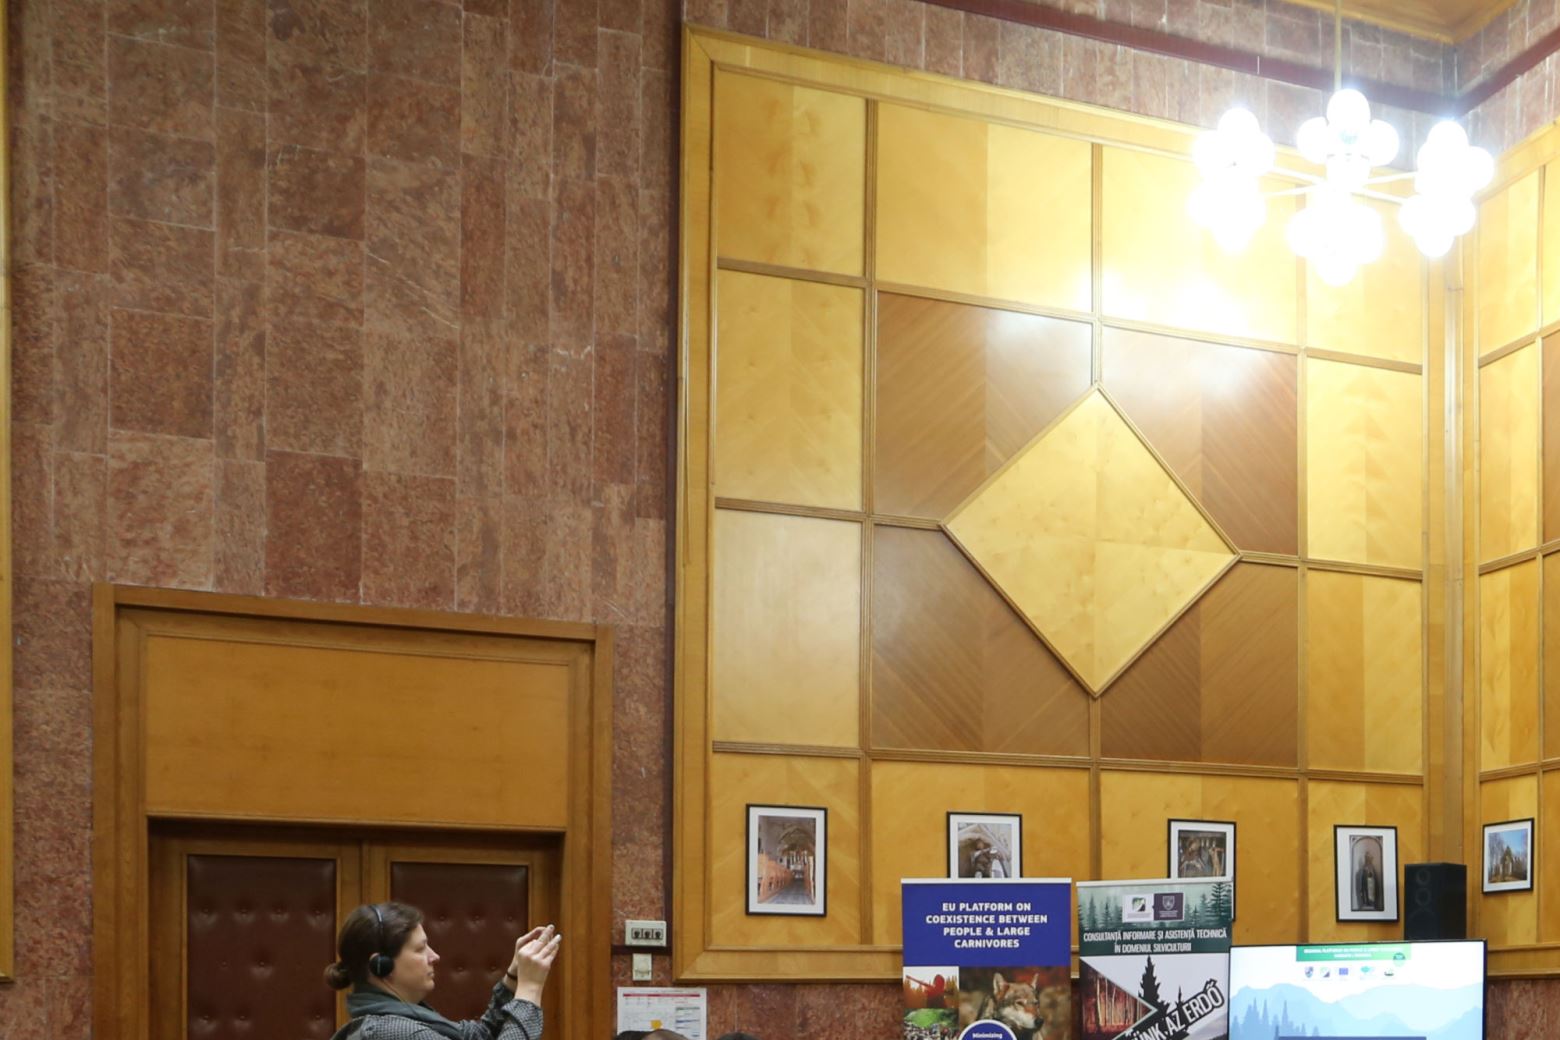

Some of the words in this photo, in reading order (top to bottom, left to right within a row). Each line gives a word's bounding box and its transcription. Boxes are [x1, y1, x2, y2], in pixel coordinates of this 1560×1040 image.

[942, 902, 956, 912] EU
[959, 902, 1013, 912] PLATFORM
[1016, 902, 1031, 912] ON
[926, 915, 995, 924] COEXISTENCE
[998, 914, 1047, 924] BETWEEN
[943, 927, 982, 936] PEOPLE
[985, 927, 994, 936] &
[997, 927, 1030, 936] LARGE
[954, 939, 1020, 949] CARNIVORES
[1165, 1009, 1186, 1036] AZ
[1182, 980, 1223, 1023] ERDŐ
